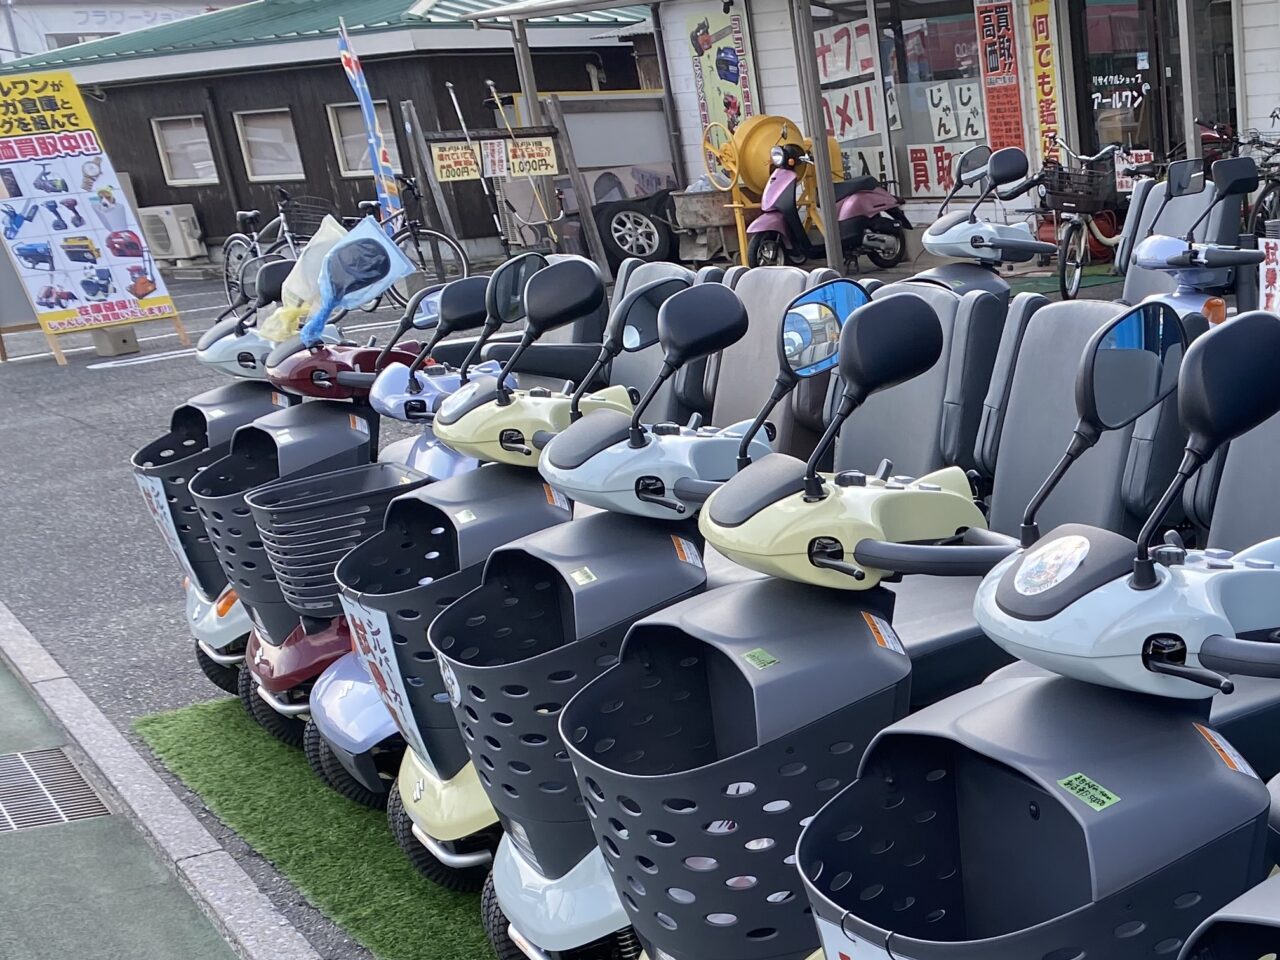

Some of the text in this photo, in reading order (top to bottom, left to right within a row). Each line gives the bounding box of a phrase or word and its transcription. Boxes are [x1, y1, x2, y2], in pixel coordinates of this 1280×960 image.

[980, 7, 999, 74] 高価
[1091, 91, 1143, 109] アールワン
[1093, 73, 1142, 86] リサイクルショップ
[929, 87, 952, 137] じゃん
[959, 86, 979, 137] じゃん
[910, 145, 955, 193] 買取
